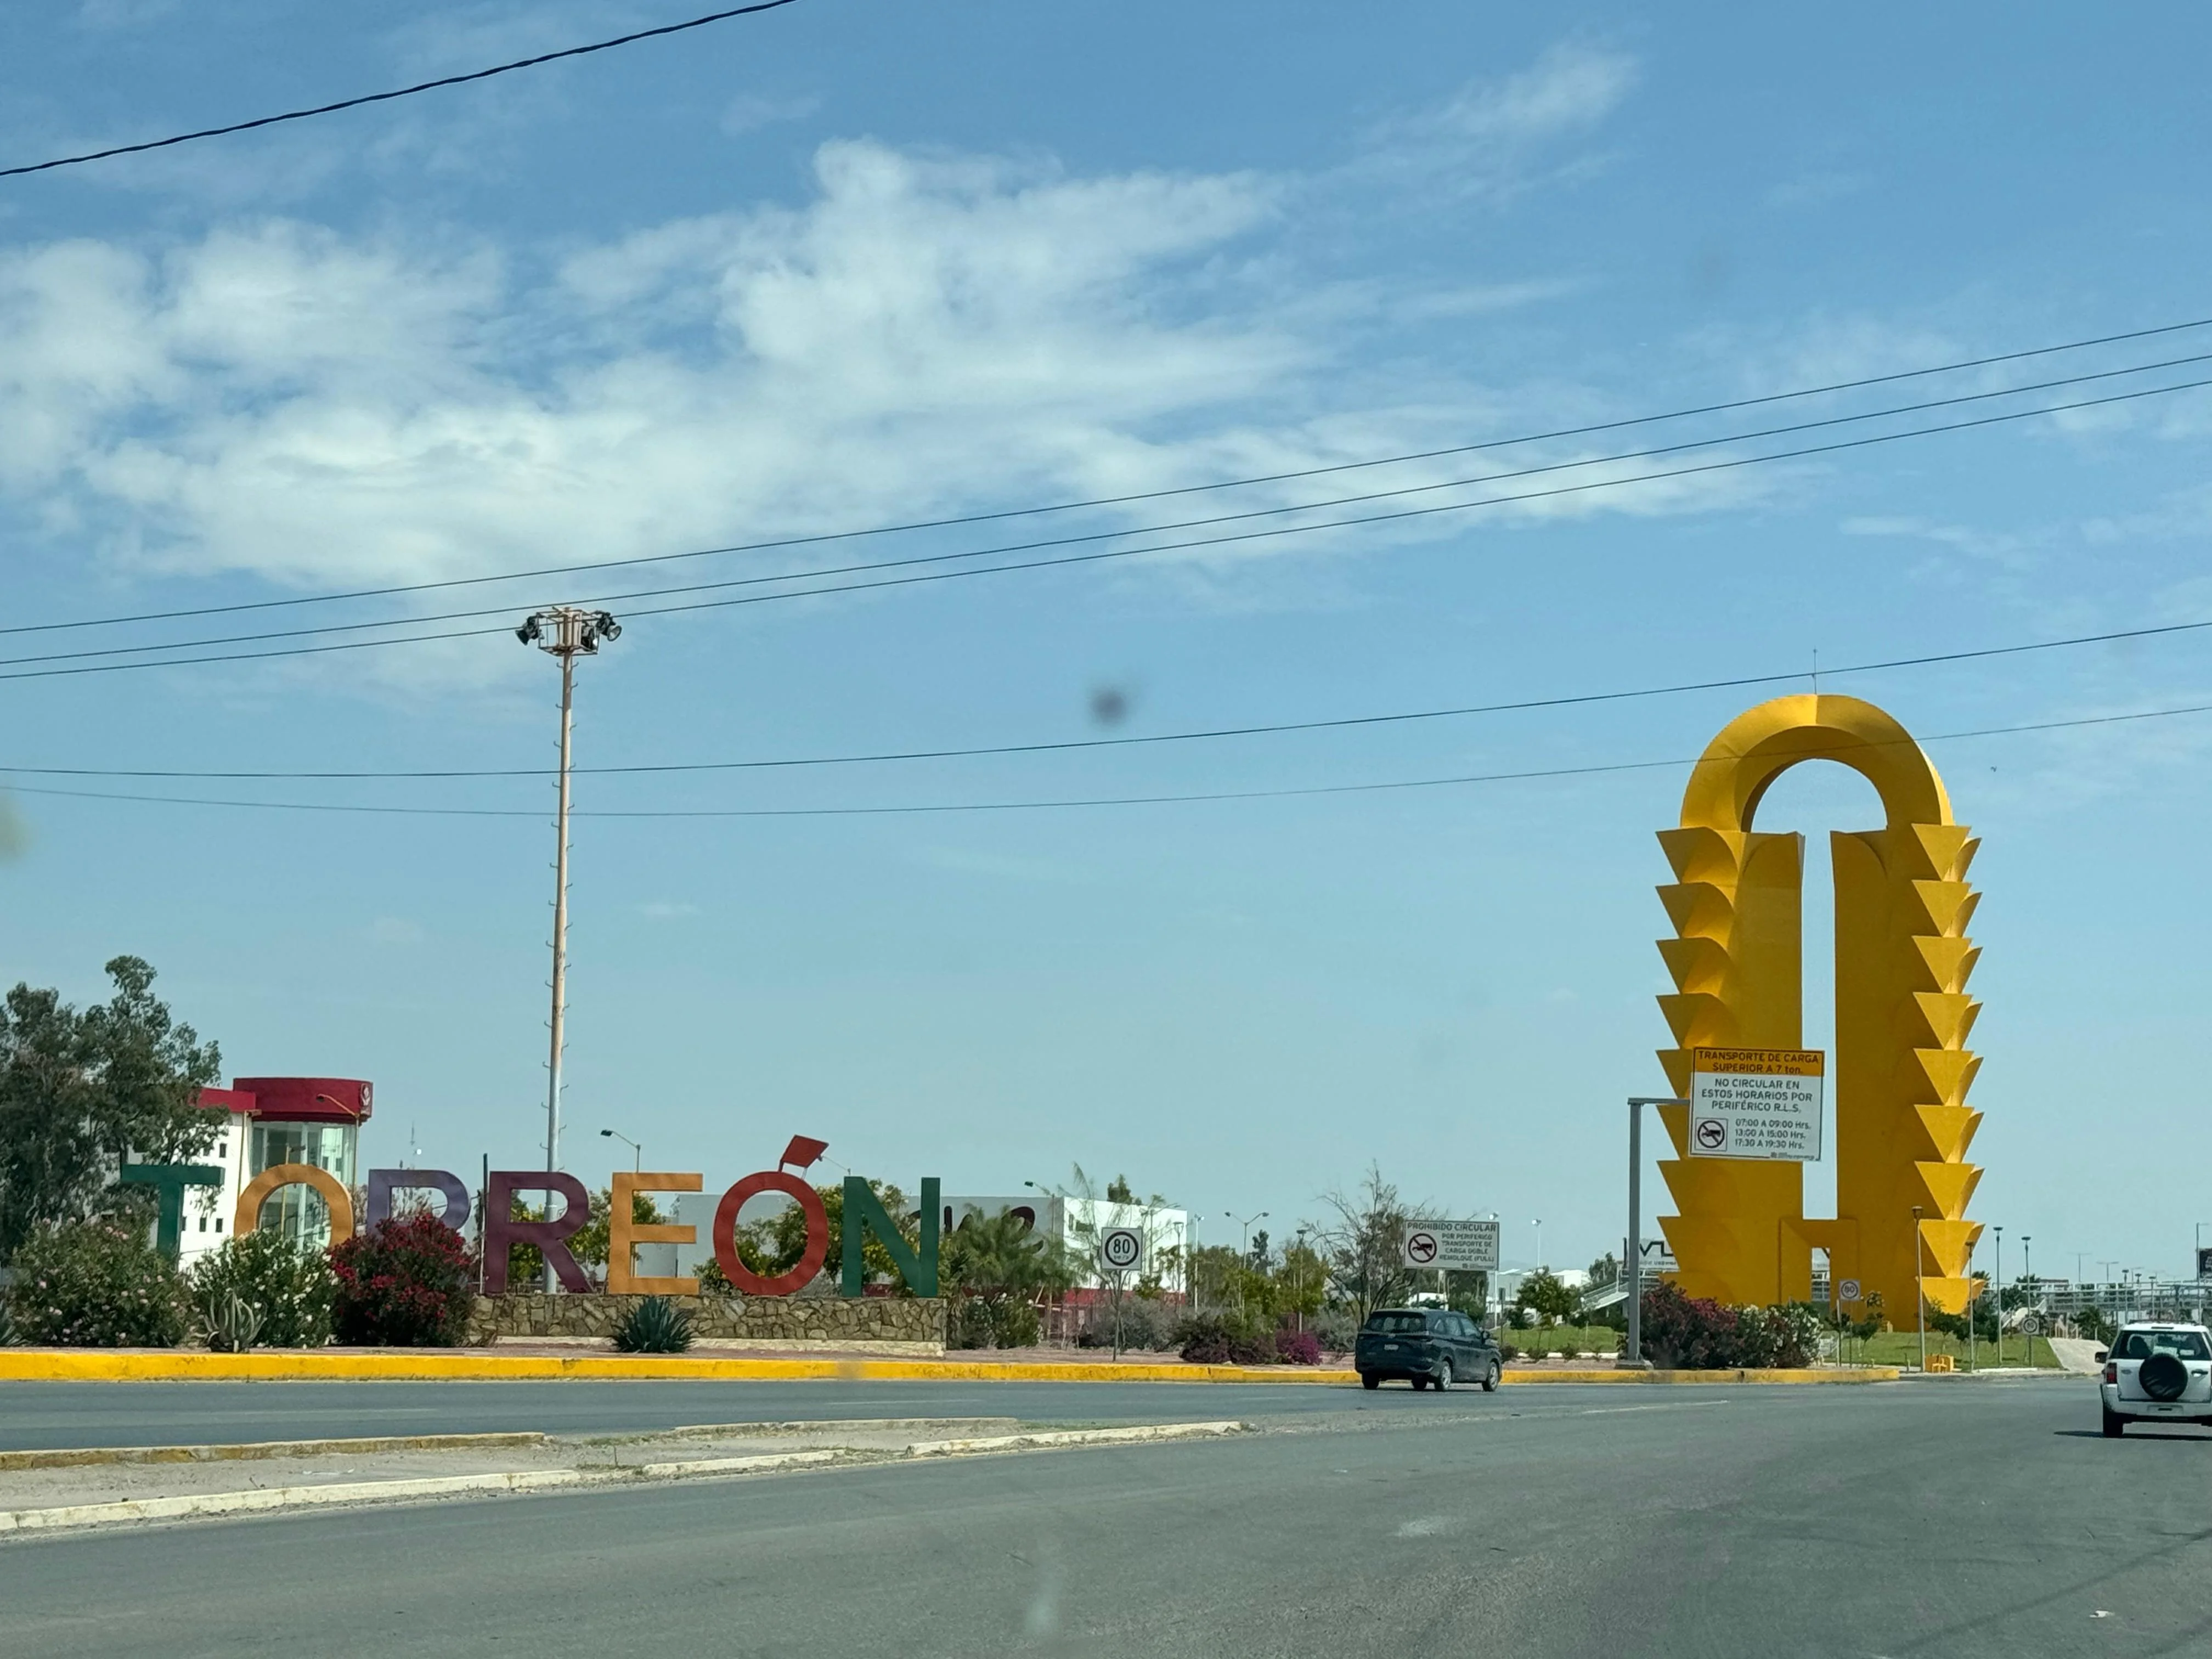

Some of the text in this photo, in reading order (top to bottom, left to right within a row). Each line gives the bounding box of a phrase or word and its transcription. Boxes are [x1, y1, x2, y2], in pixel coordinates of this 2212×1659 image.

[1699, 1051, 1819, 1063] TRANSPORTE DE CARGA
[1713, 1062, 1765, 1073] SUPERIOR
[1767, 1065, 1774, 1073] A
[1715, 1078, 1799, 1089] NO CIRCULAR EN
[1702, 1088, 1813, 1102] ESTOS HORARIOS POR
[1712, 1099, 1771, 1111] PERIFÉRICO
[1736, 1119, 1759, 1127] 07:00
[1736, 1128, 1757, 1137] 13:00
[1767, 1130, 1788, 1138] 15:00
[1735, 1138, 1756, 1147] 17:30
[1408, 1222, 1496, 1232] PROHIBIDO CIRCULAR
[1113, 1238, 1130, 1254] 80
